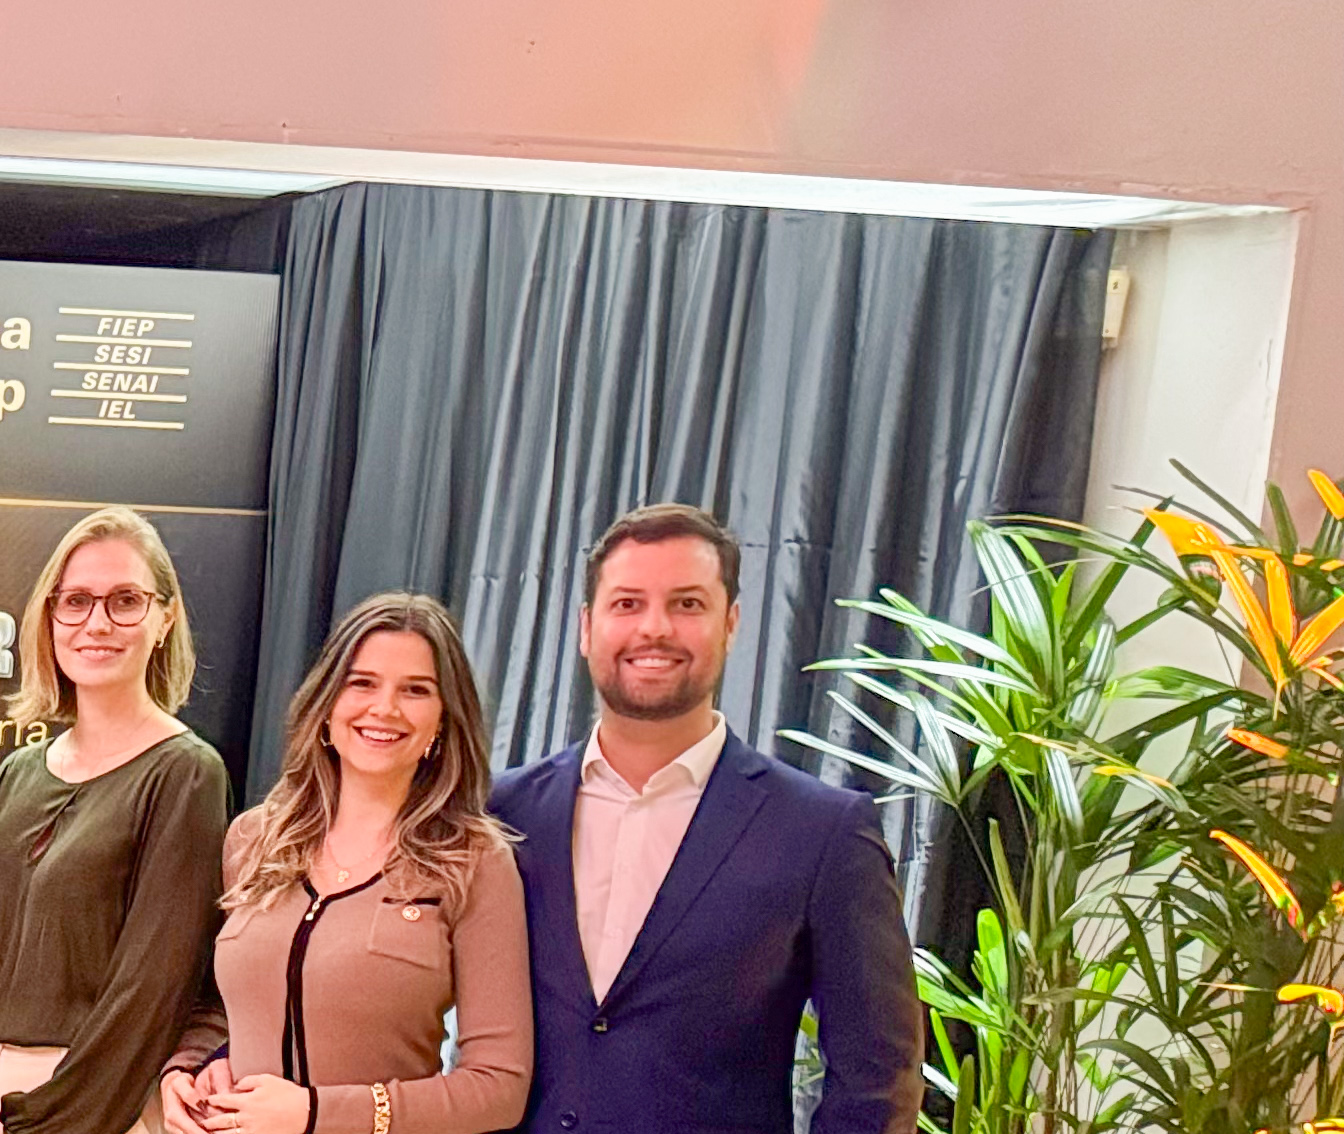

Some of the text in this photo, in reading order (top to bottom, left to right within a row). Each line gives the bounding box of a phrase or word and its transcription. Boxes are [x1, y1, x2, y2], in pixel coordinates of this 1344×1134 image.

[97, 317, 154, 337] FIEP
[94, 344, 152, 365] SESI
[82, 371, 159, 393] SENAI
[98, 399, 136, 419] IEL
